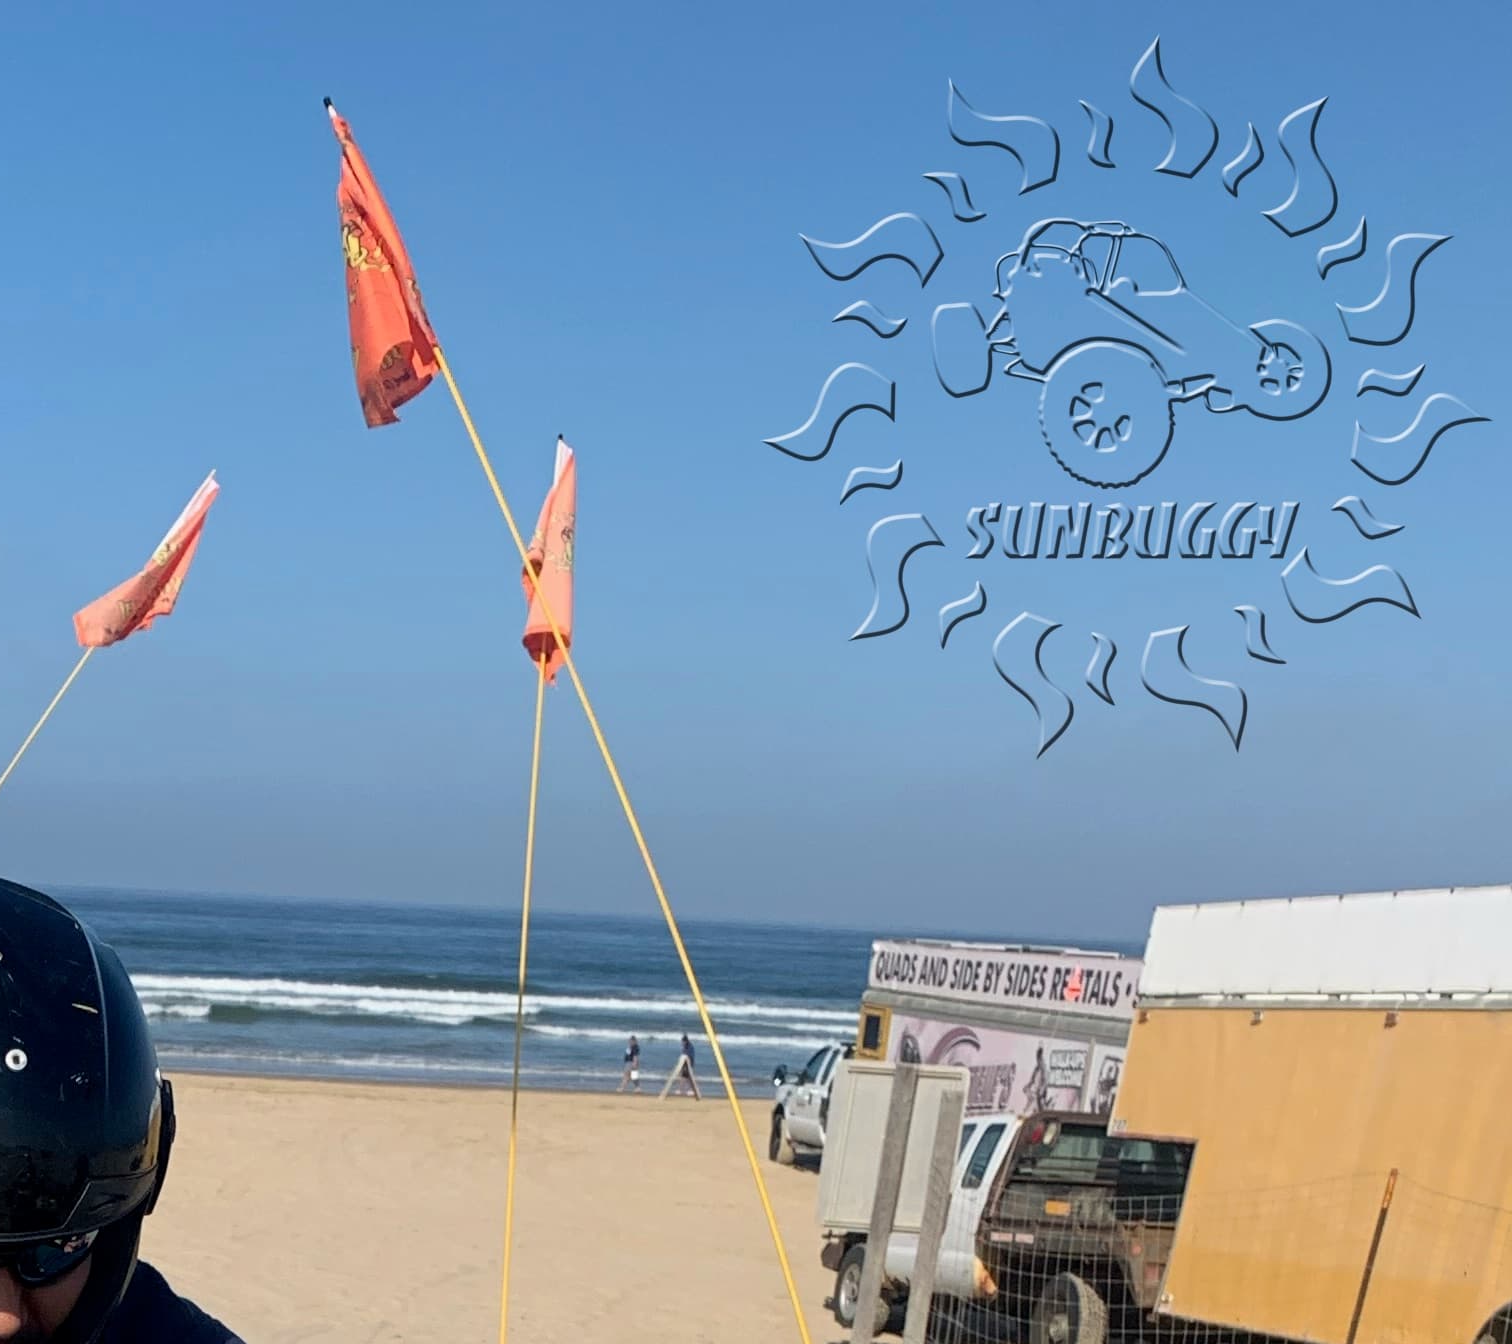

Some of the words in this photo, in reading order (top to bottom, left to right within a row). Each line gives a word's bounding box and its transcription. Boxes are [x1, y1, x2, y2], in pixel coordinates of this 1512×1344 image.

[875, 951, 916, 983] QUADS
[919, 955, 949, 987] AND
[949, 959, 981, 992] SIDE
[983, 962, 1002, 995] BY
[1004, 963, 1047, 998] SIDES
